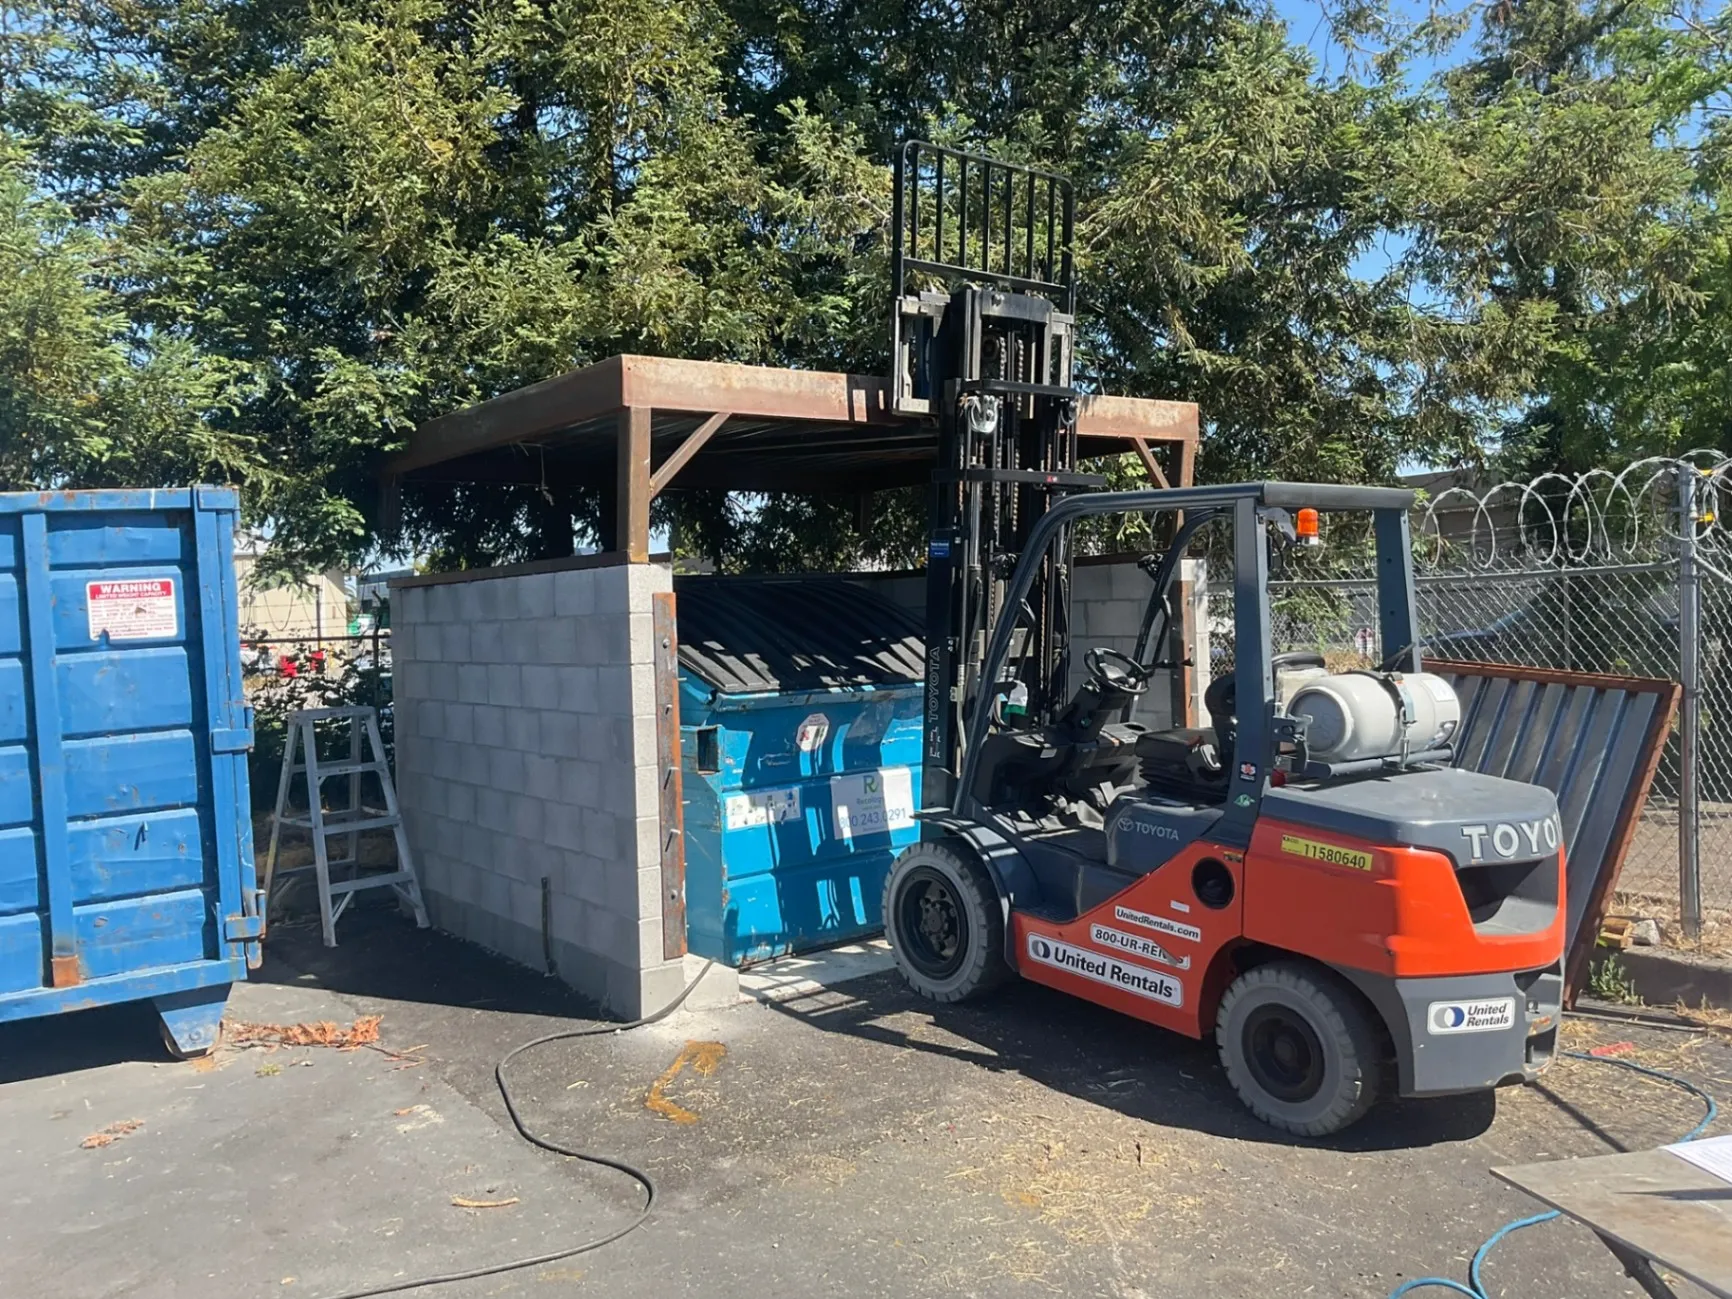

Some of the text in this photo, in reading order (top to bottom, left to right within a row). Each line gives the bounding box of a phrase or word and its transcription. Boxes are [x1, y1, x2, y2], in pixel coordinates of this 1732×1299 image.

[100, 582, 161, 594] WARNING
[928, 646, 940, 723] TOYOTA
[1135, 821, 1180, 841] TOYOTA
[1461, 814, 1560, 859] TOYO
[1304, 843, 1366, 869] 11580640
[1116, 907, 1200, 940] UnitedRentals.com
[1053, 946, 1174, 998] United Rentals
[1466, 1014, 1510, 1027] Rentals
[1467, 1003, 1508, 1017] United
